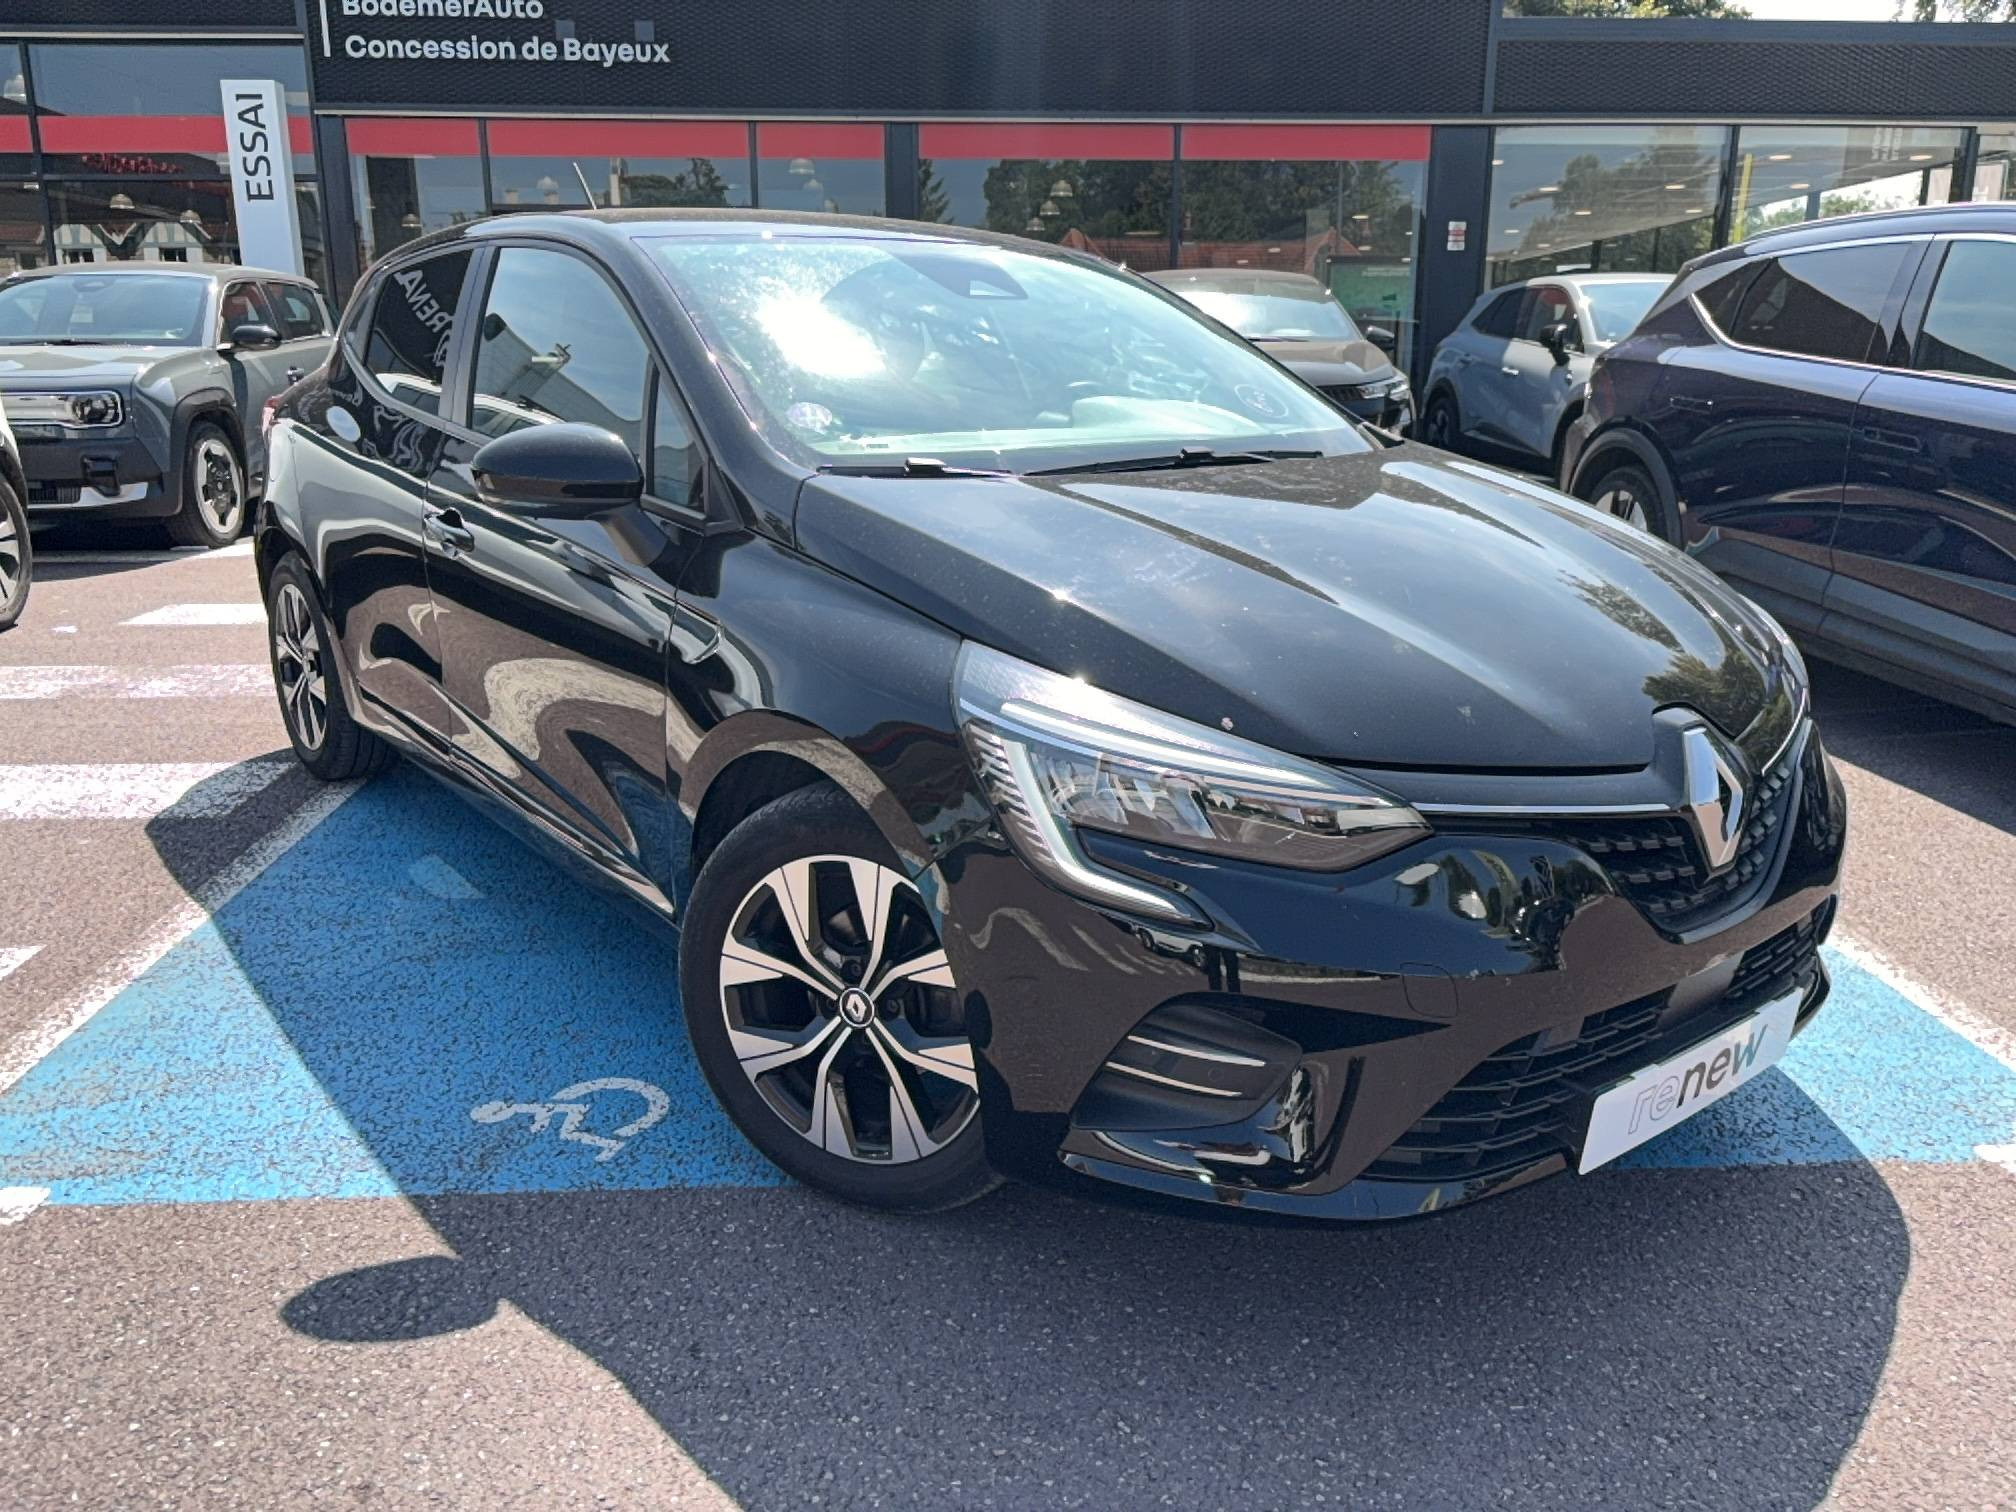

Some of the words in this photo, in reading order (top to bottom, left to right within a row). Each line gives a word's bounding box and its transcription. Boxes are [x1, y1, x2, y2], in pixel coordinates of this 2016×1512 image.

[342, 0, 544, 18] BodemerAuto
[344, 35, 517, 60] Concession
[521, 36, 558, 61] de
[563, 37, 671, 67] Bayeux
[235, 93, 274, 202] ESSAI
[1628, 1024, 1768, 1135] renew
